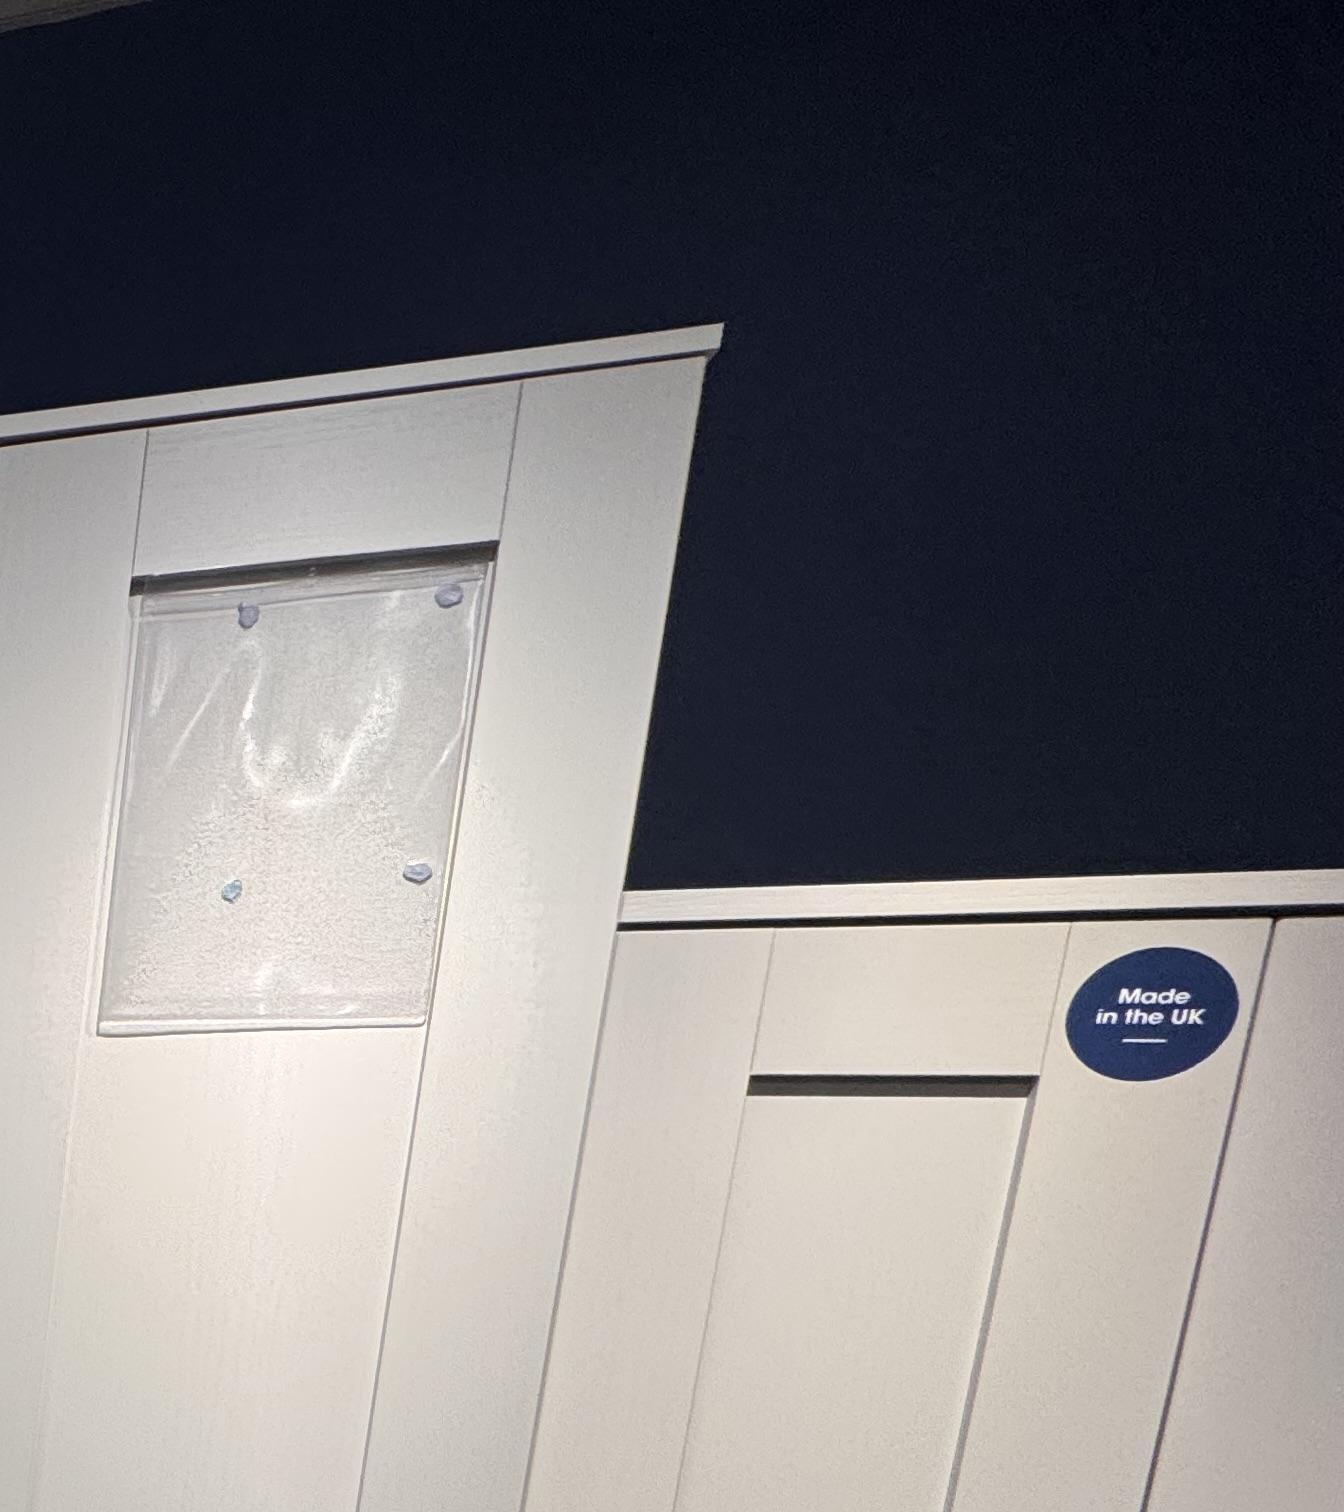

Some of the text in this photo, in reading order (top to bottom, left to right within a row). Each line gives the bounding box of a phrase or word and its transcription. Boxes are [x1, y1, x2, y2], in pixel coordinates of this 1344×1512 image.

[1118, 988, 1192, 1005] Made
[1095, 1009, 1207, 1025] in the UK
